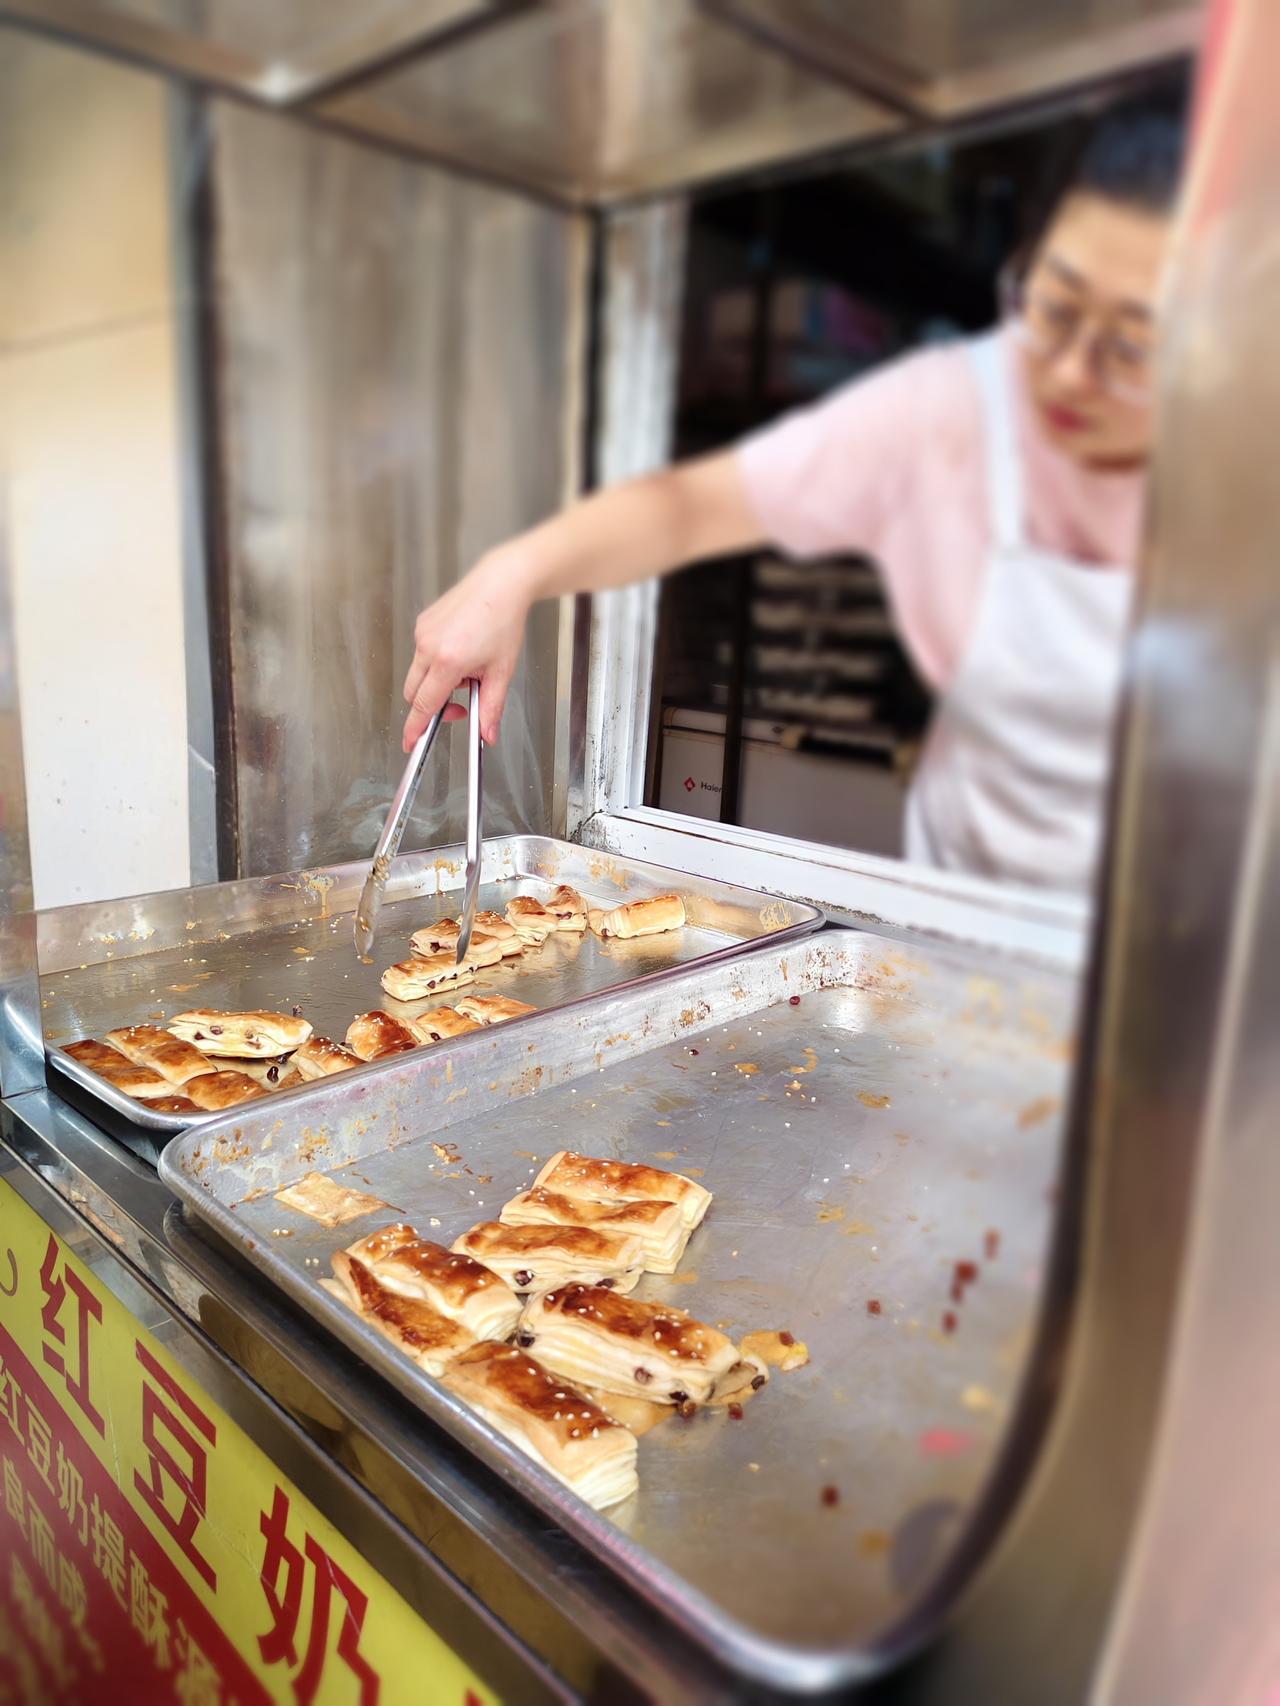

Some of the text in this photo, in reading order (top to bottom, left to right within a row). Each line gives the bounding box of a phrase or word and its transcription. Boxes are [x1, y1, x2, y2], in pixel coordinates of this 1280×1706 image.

[700, 781, 722, 793] Haier
[39, 1232, 482, 1706] 红豆奶
